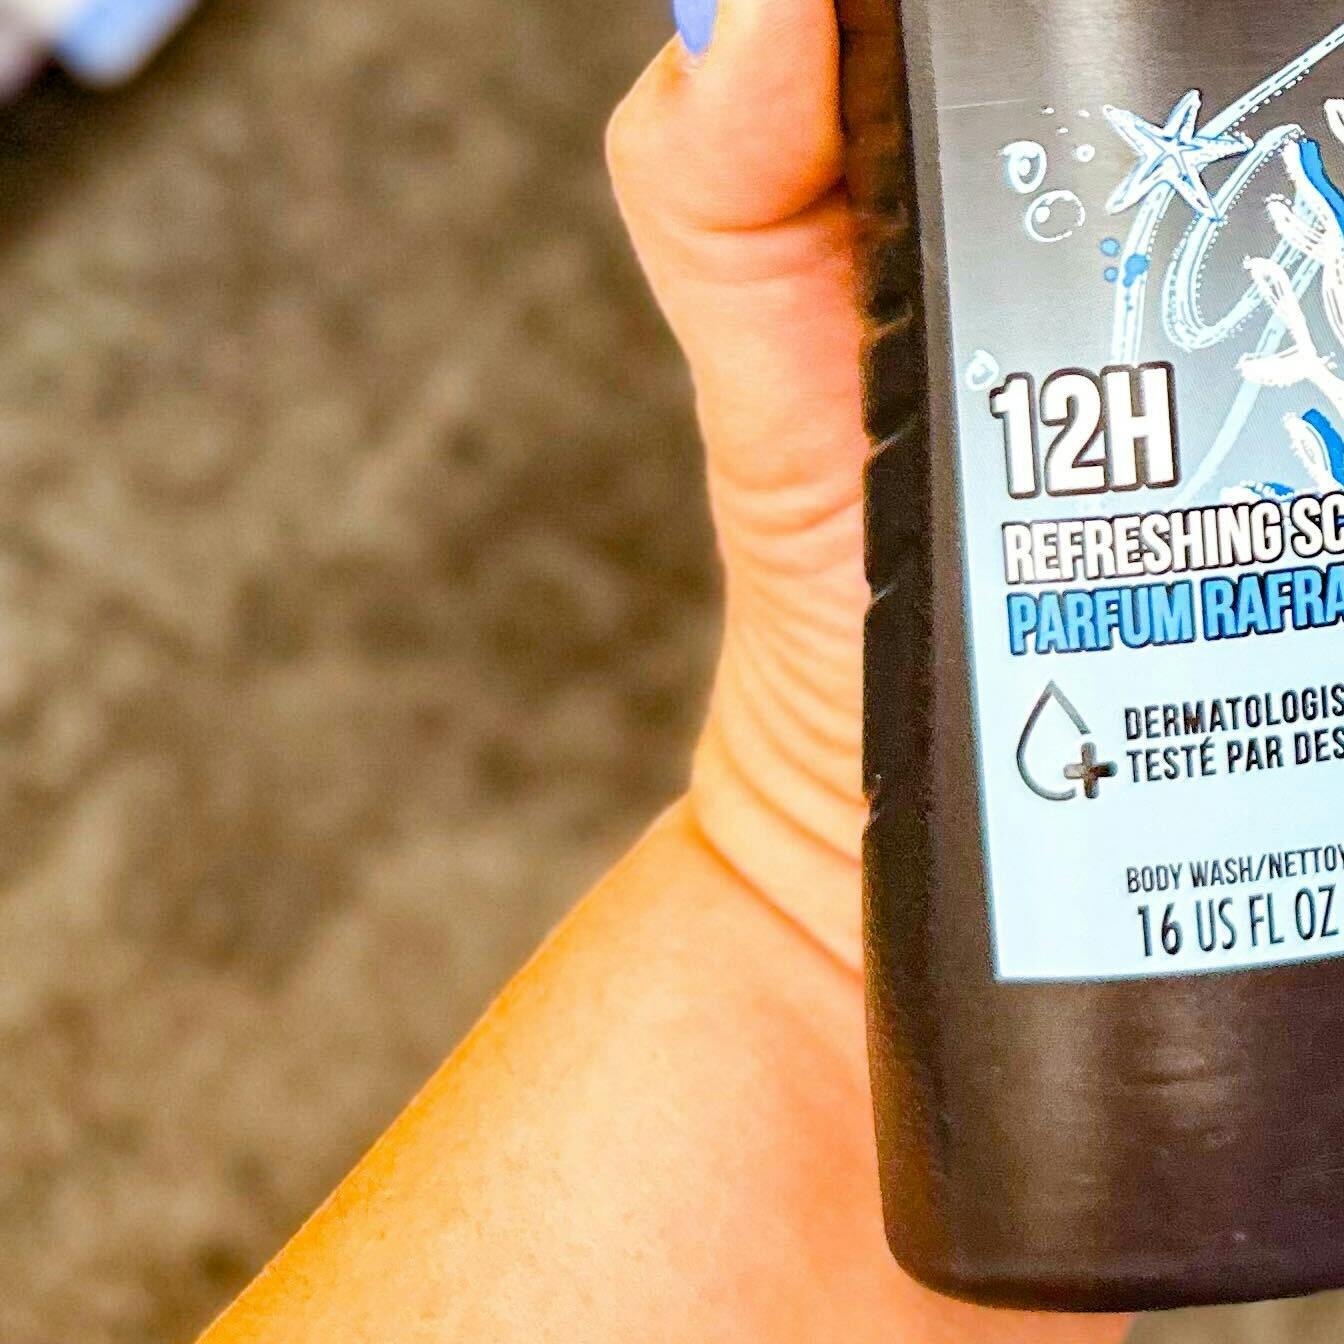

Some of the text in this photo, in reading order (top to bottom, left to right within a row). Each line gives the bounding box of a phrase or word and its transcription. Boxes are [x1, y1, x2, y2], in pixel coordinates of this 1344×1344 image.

[990, 362, 1180, 499] 12H
[1002, 498, 1284, 584] REFRESHING
[1007, 578, 1196, 656] PARFUM
[1126, 736, 1217, 784] TESTÉ
[1227, 737, 1284, 774] PAR
[1126, 863, 1183, 894] BODY
[1137, 902, 1184, 957] 16
[1195, 896, 1238, 953] US
[1248, 890, 1285, 947] FL
[1294, 883, 1339, 941] OZ
